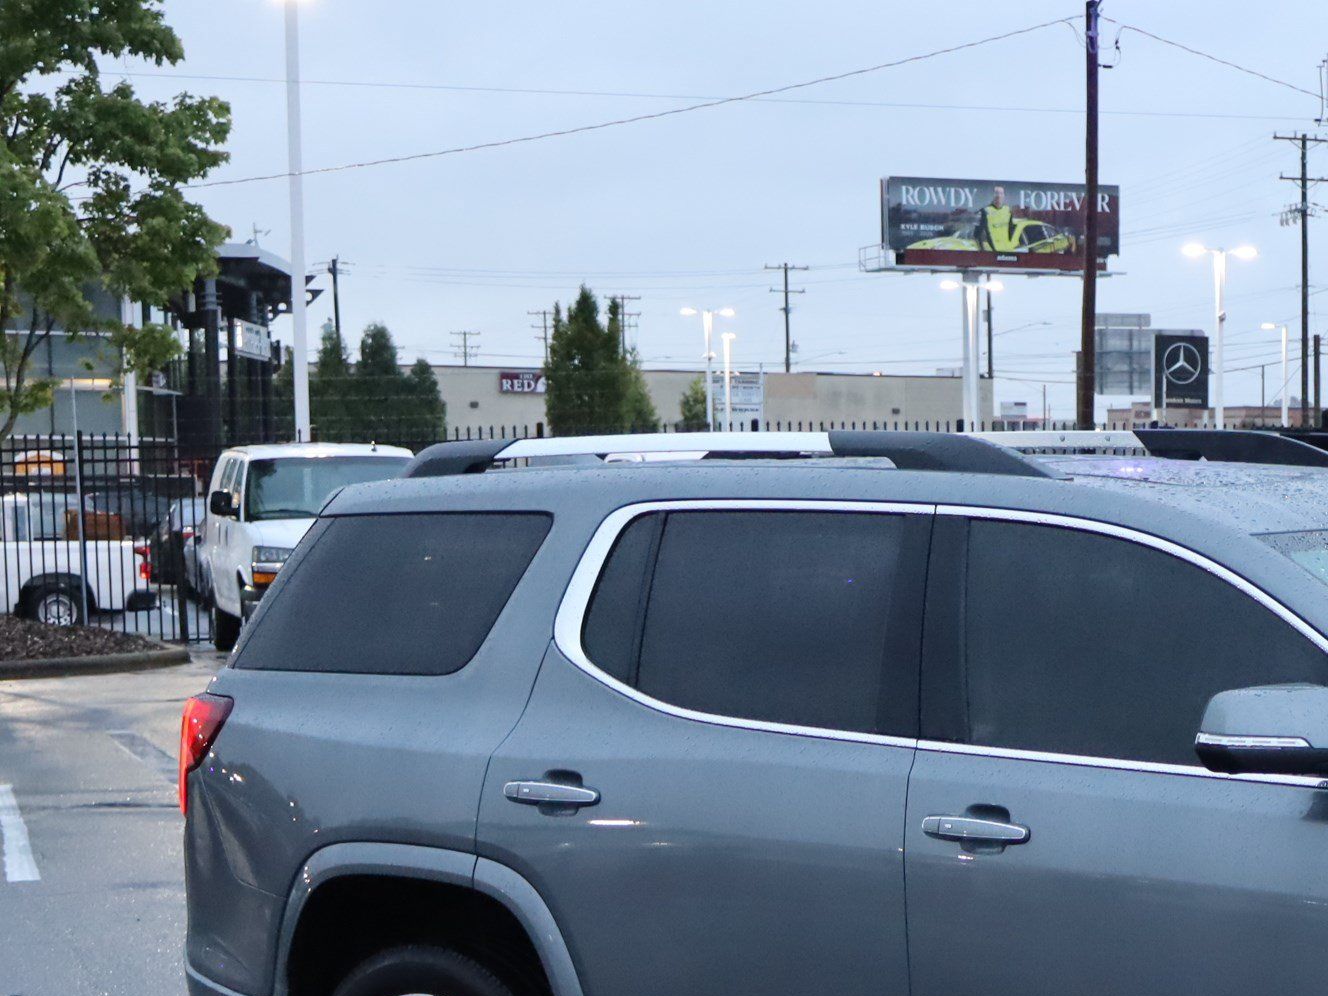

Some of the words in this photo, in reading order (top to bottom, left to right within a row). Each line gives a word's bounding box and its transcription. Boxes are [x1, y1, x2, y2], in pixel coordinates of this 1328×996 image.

[901, 185, 977, 207] ROWDY
[1019, 189, 1111, 213] FOREVR
[502, 379, 535, 391] RED
